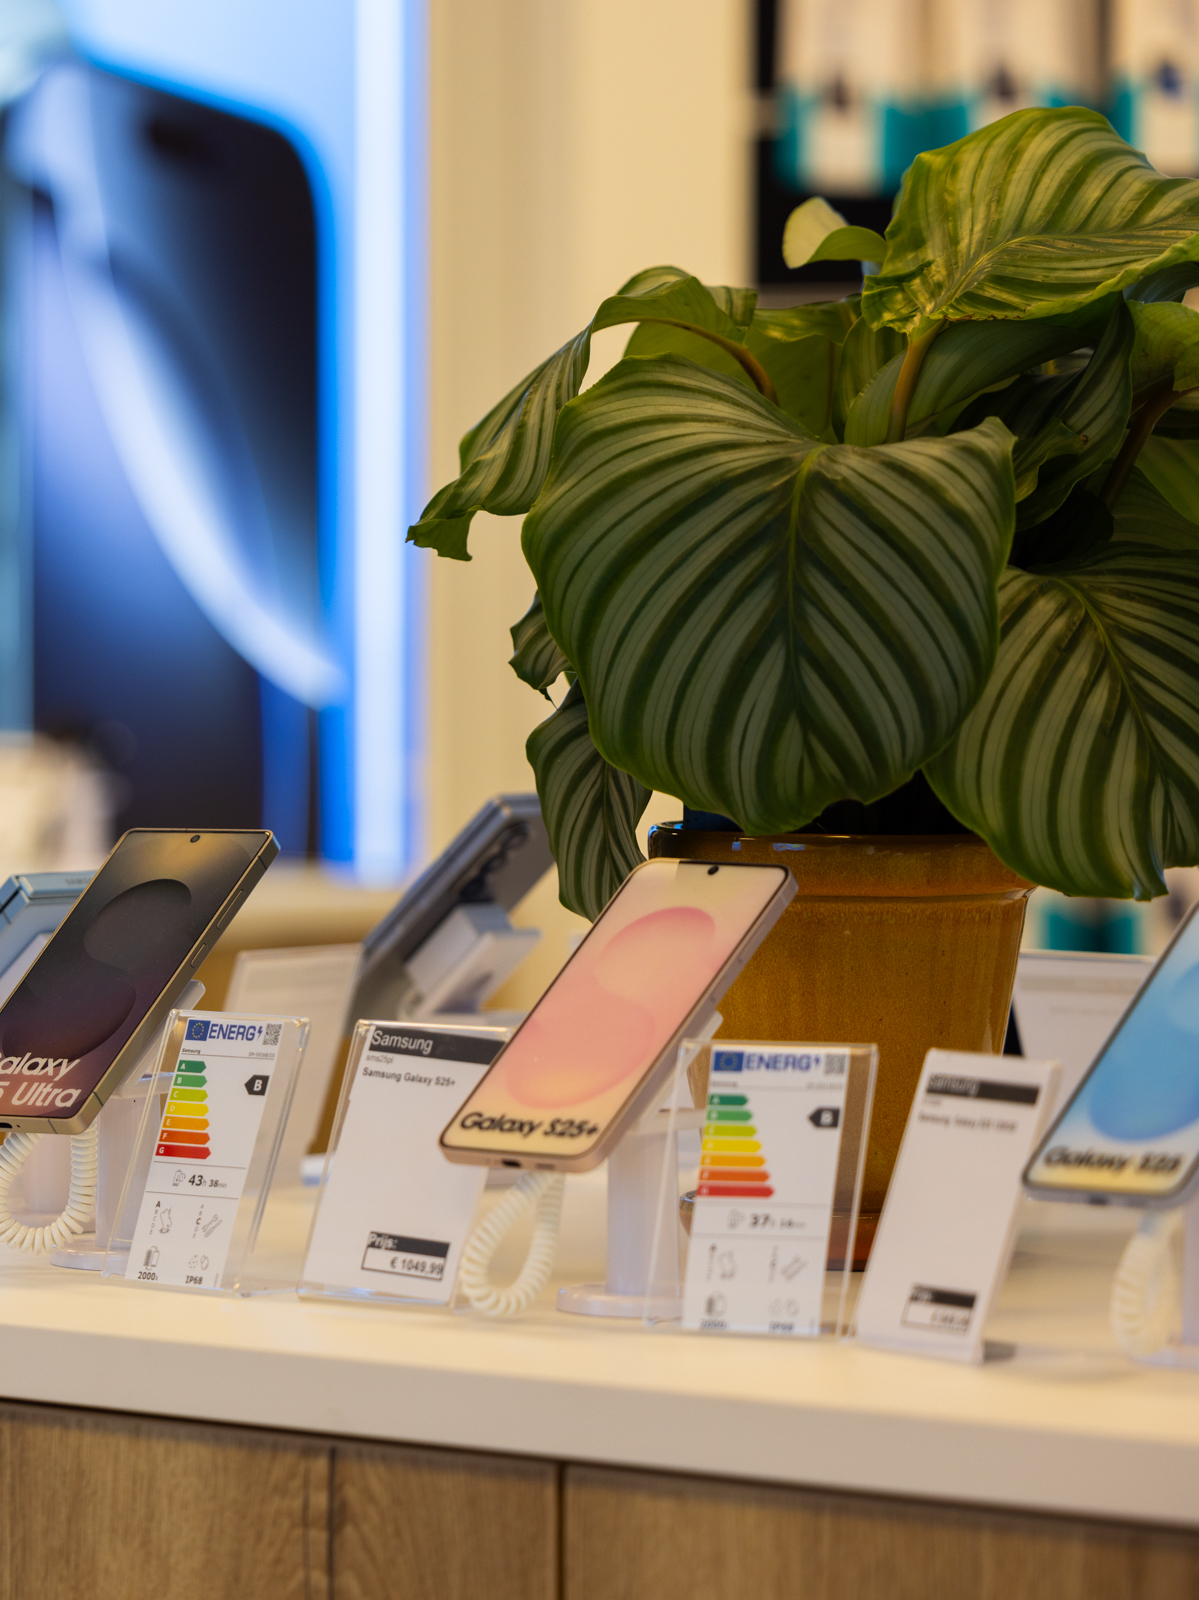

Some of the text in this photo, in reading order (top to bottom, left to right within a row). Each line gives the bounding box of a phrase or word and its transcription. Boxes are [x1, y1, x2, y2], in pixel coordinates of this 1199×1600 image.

[208, 1023, 256, 1041] ENERG
[181, 1047, 201, 1055] Samsung
[372, 1030, 433, 1055] Samsung
[180, 1062, 186, 1070] A
[253, 1079, 263, 1092] B
[362, 1067, 455, 1087] Samsung Galaxy S25+
[929, 1074, 979, 1097] Samsung
[11, 1081, 82, 1107] Ultra
[460, 1111, 599, 1139] Galaxy S25+
[1043, 1146, 1129, 1175] Galaxy
[368, 1233, 398, 1249] Prijs:
[390, 1257, 443, 1275] € 1049,99
[185, 1275, 203, 1285] IP68
